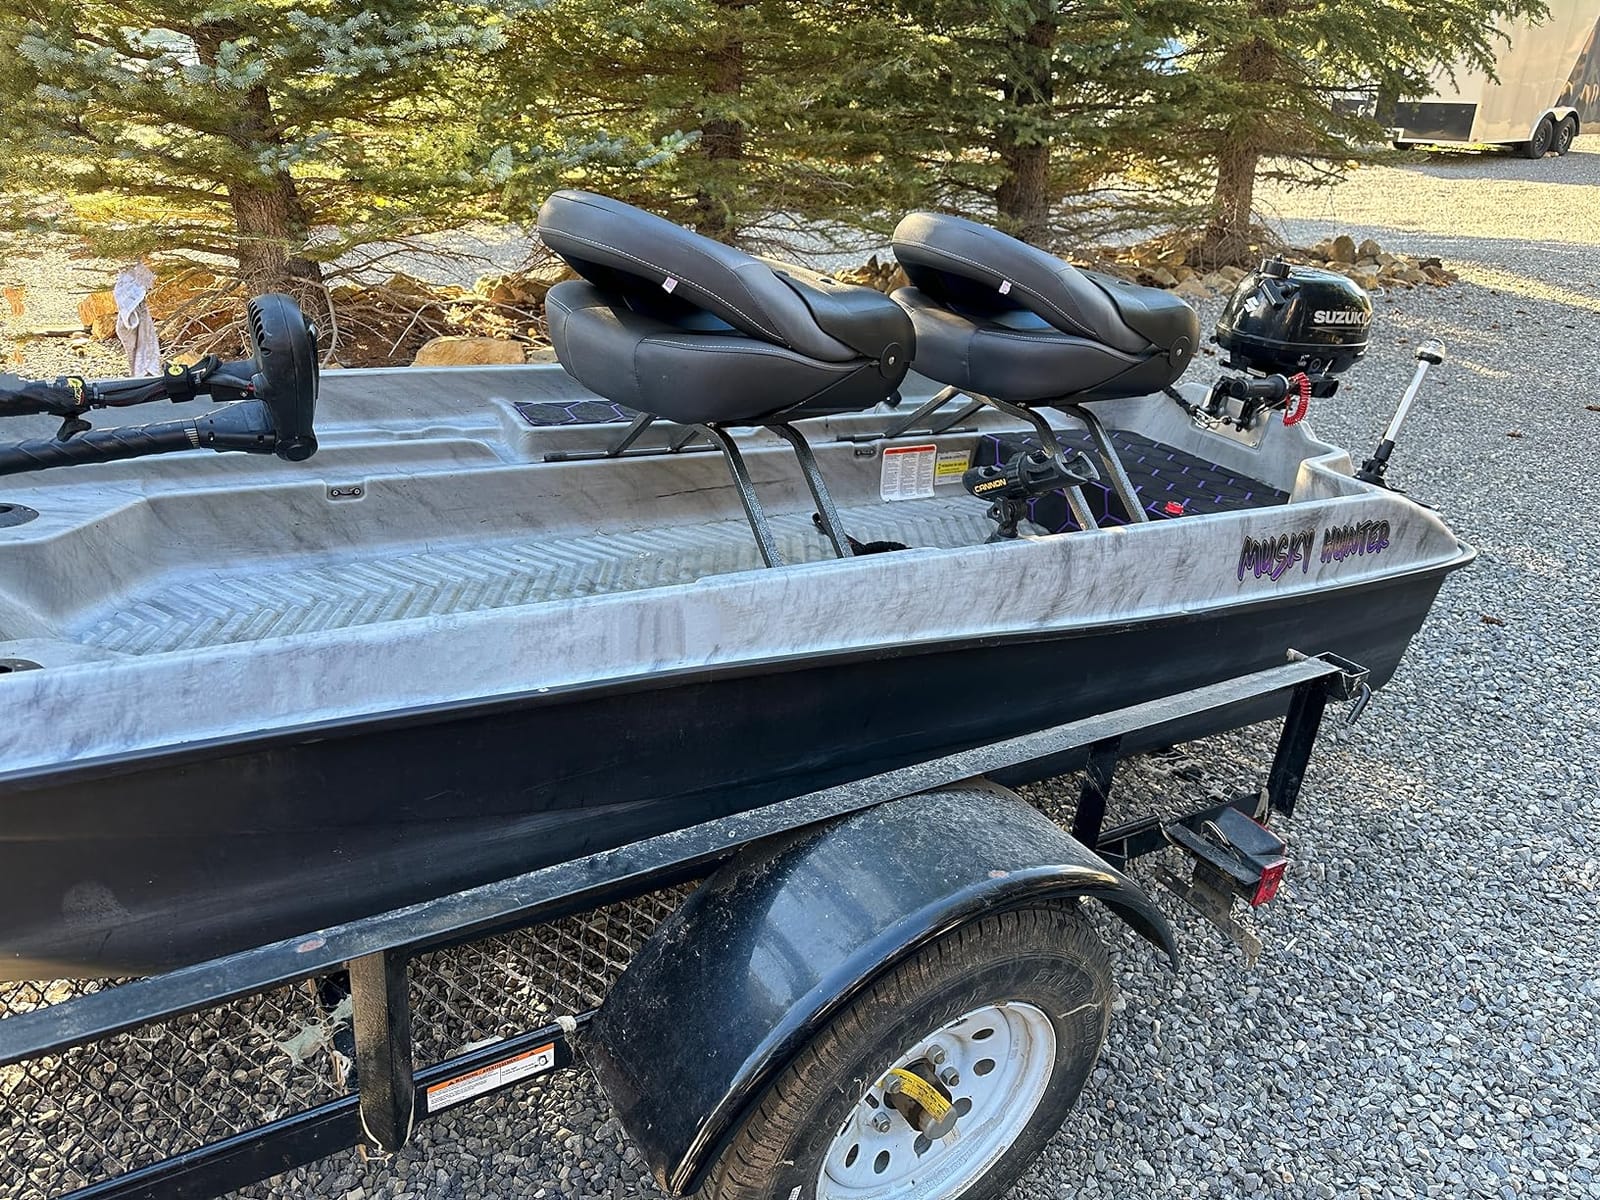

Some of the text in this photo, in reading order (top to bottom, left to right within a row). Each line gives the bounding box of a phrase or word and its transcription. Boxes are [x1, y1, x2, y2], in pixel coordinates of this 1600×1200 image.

[1314, 311, 1365, 324] SUZUKI
[974, 478, 1006, 493] CANNON
[1237, 520, 1390, 581] MUSKY HUNTER
